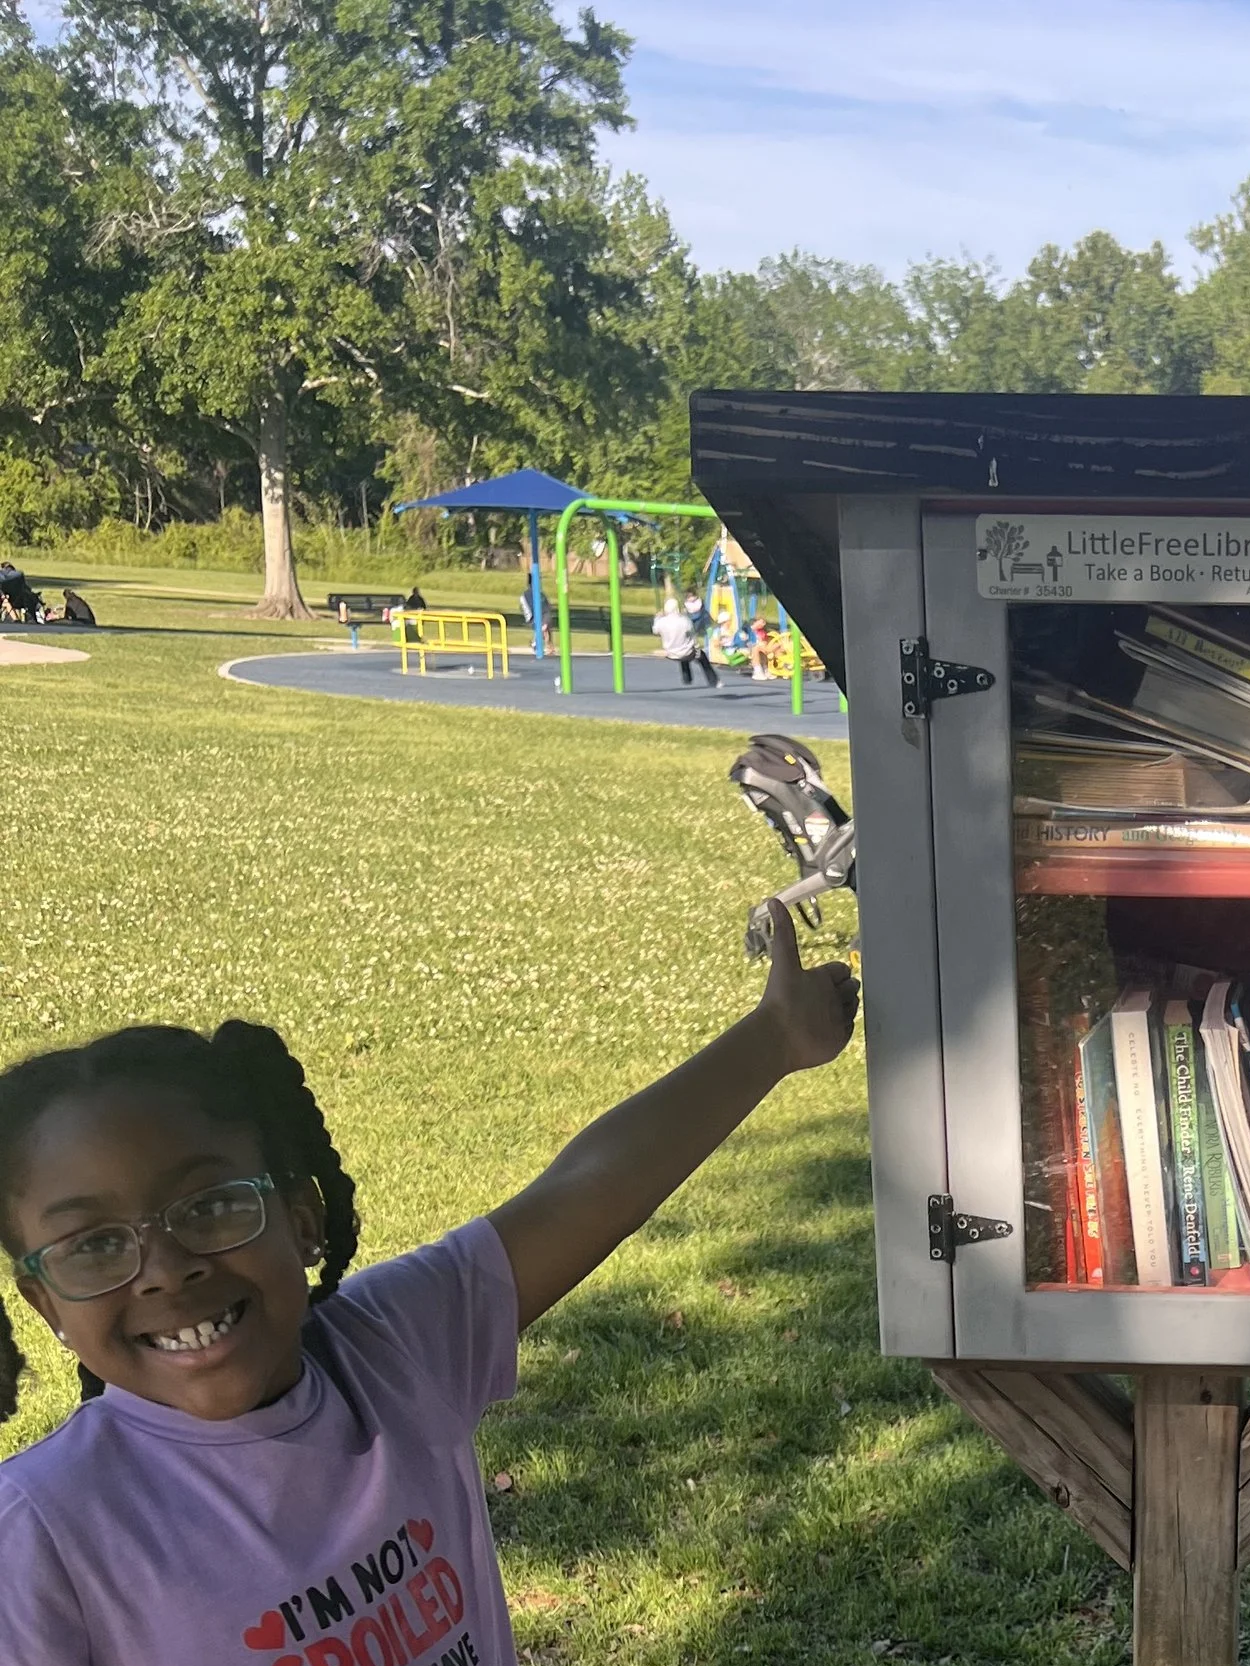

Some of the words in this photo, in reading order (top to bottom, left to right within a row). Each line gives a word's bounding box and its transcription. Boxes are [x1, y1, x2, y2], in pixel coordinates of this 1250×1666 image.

[1084, 563, 1128, 581] Take
[1133, 567, 1144, 582] a
[1150, 563, 1196, 582] Book
[1035, 585, 1073, 598] 35430
[1037, 824, 1111, 842] HISTORY
[1121, 827, 1150, 842] and
[1174, 1031, 1188, 1062] The
[1176, 1064, 1193, 1104] Child
[1178, 1105, 1194, 1155] Finder
[1204, 1118, 1220, 1149] NORA
[1182, 1167, 1195, 1201] Rene
[1183, 1201, 1200, 1258] Denfeld
[279, 1575, 356, 1642] I'M
[350, 1525, 419, 1605] NOT
